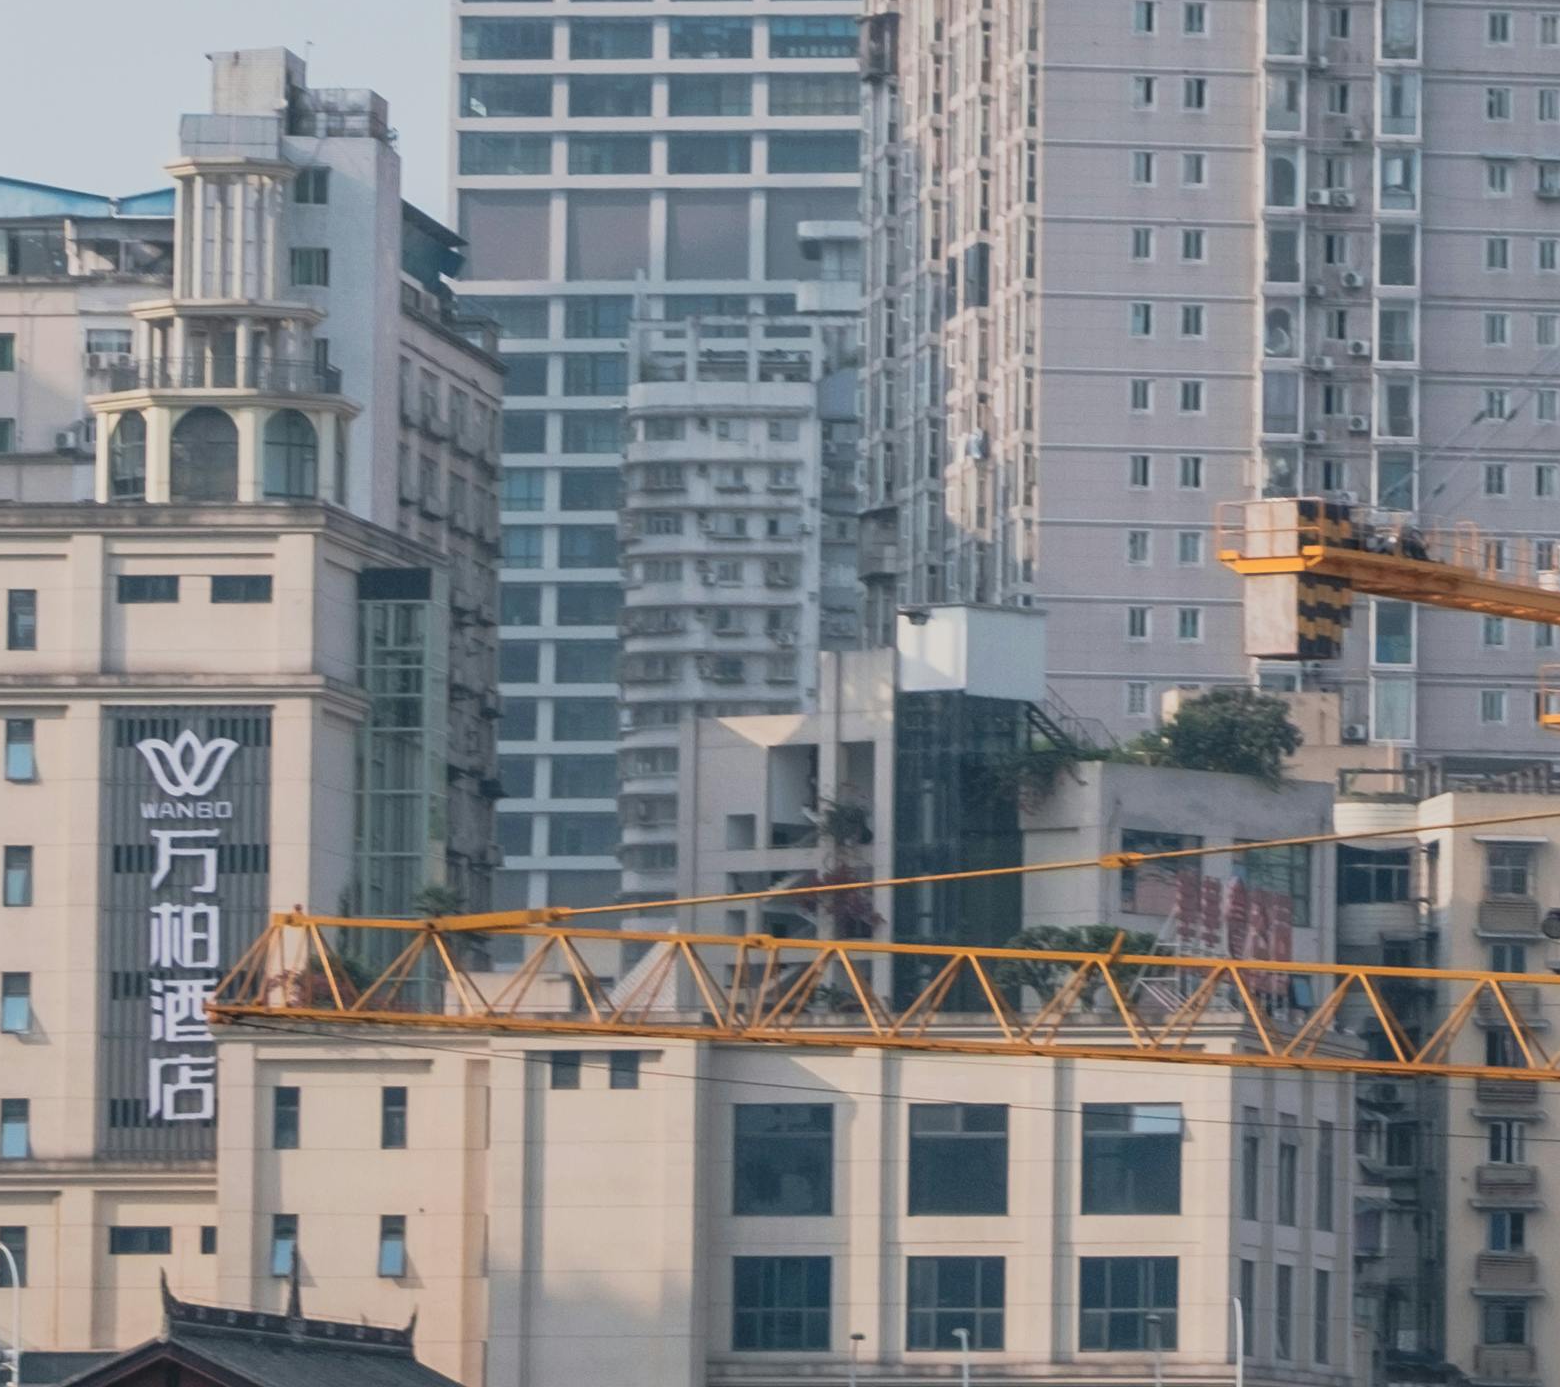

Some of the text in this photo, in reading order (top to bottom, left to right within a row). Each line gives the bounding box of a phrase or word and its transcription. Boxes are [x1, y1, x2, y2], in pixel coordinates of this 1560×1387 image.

[140, 801, 233, 819] WANBO
[147, 828, 221, 1120] 万柏酒店
